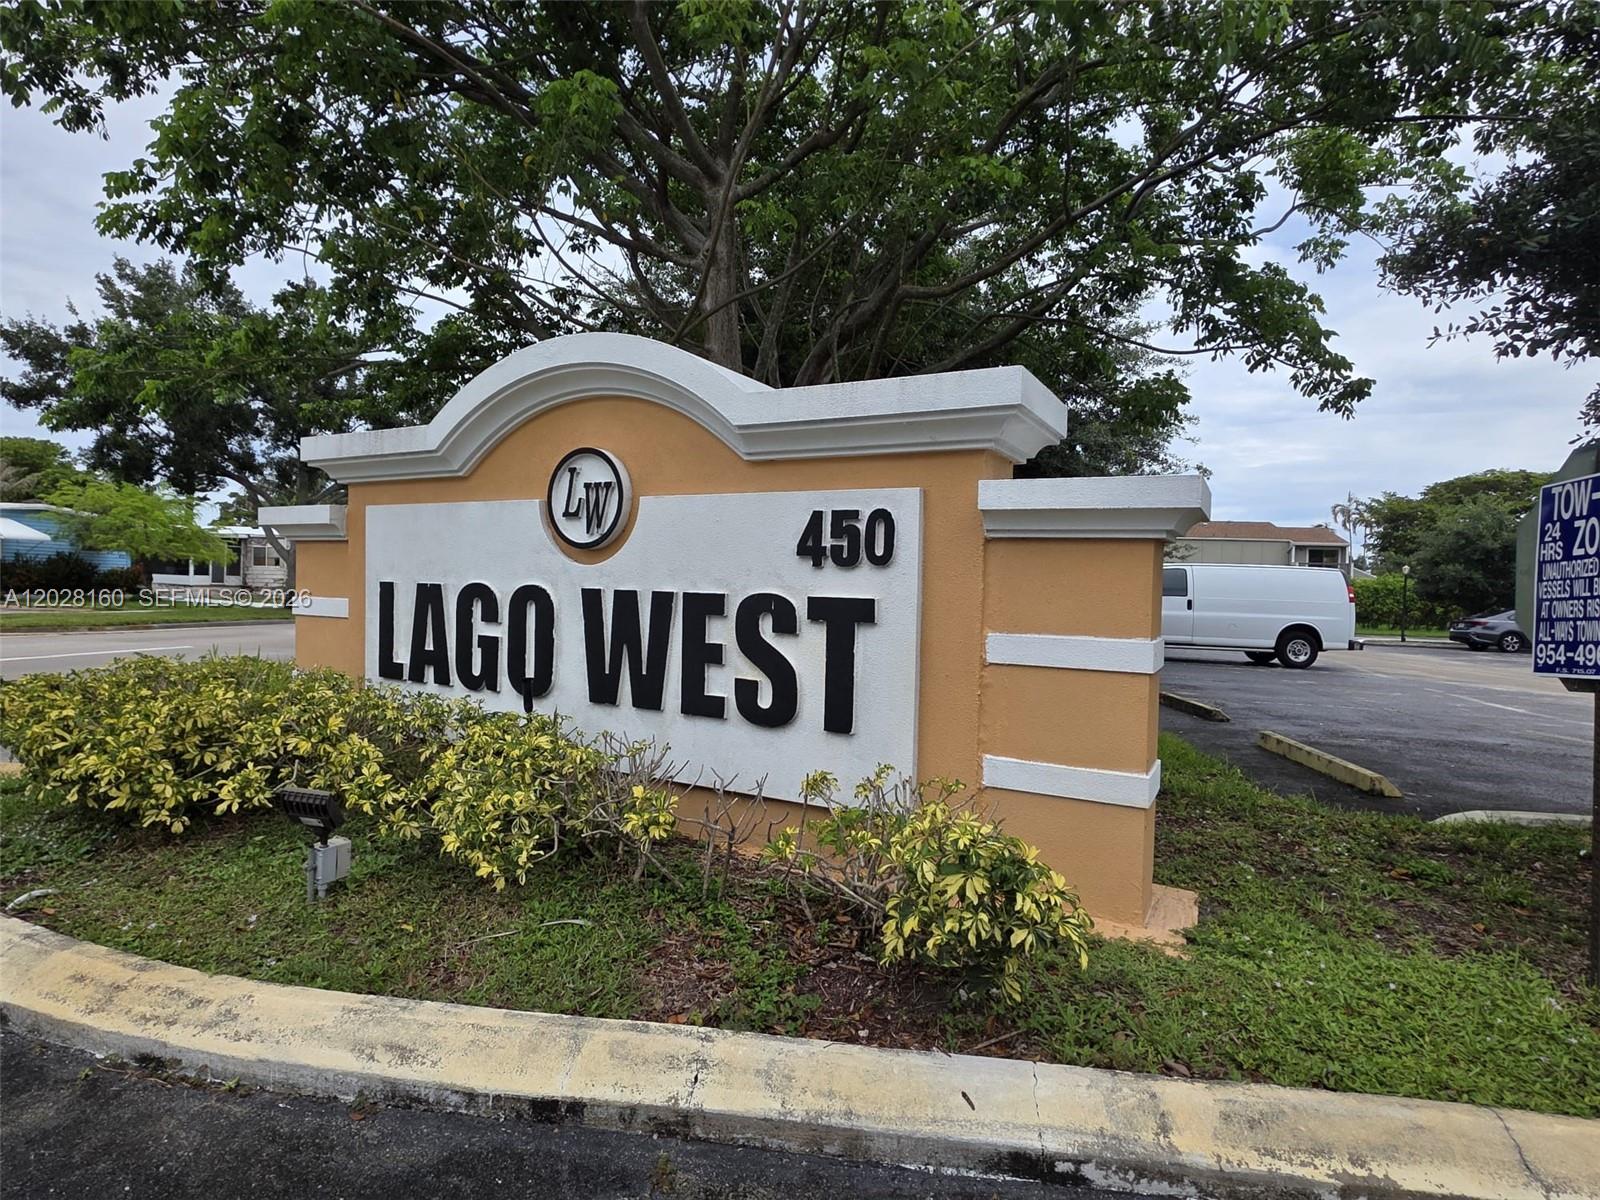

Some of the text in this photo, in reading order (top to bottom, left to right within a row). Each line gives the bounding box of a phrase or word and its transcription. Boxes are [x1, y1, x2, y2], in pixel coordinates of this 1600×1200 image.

[562, 467, 612, 534] LW
[796, 508, 896, 567] 450
[1544, 521, 1561, 542] 24
[1540, 541, 1563, 561] HRS
[1542, 556, 1599, 580] UNAUTHORIZED
[1538, 579, 1571, 599] VESSELS
[1573, 578, 1591, 597] WILL
[1540, 601, 1550, 619] AT
[1551, 599, 1584, 618] OWNERS
[1538, 620, 1574, 642] ALL-WAYS
[378, 581, 876, 734] LAGO WEST
